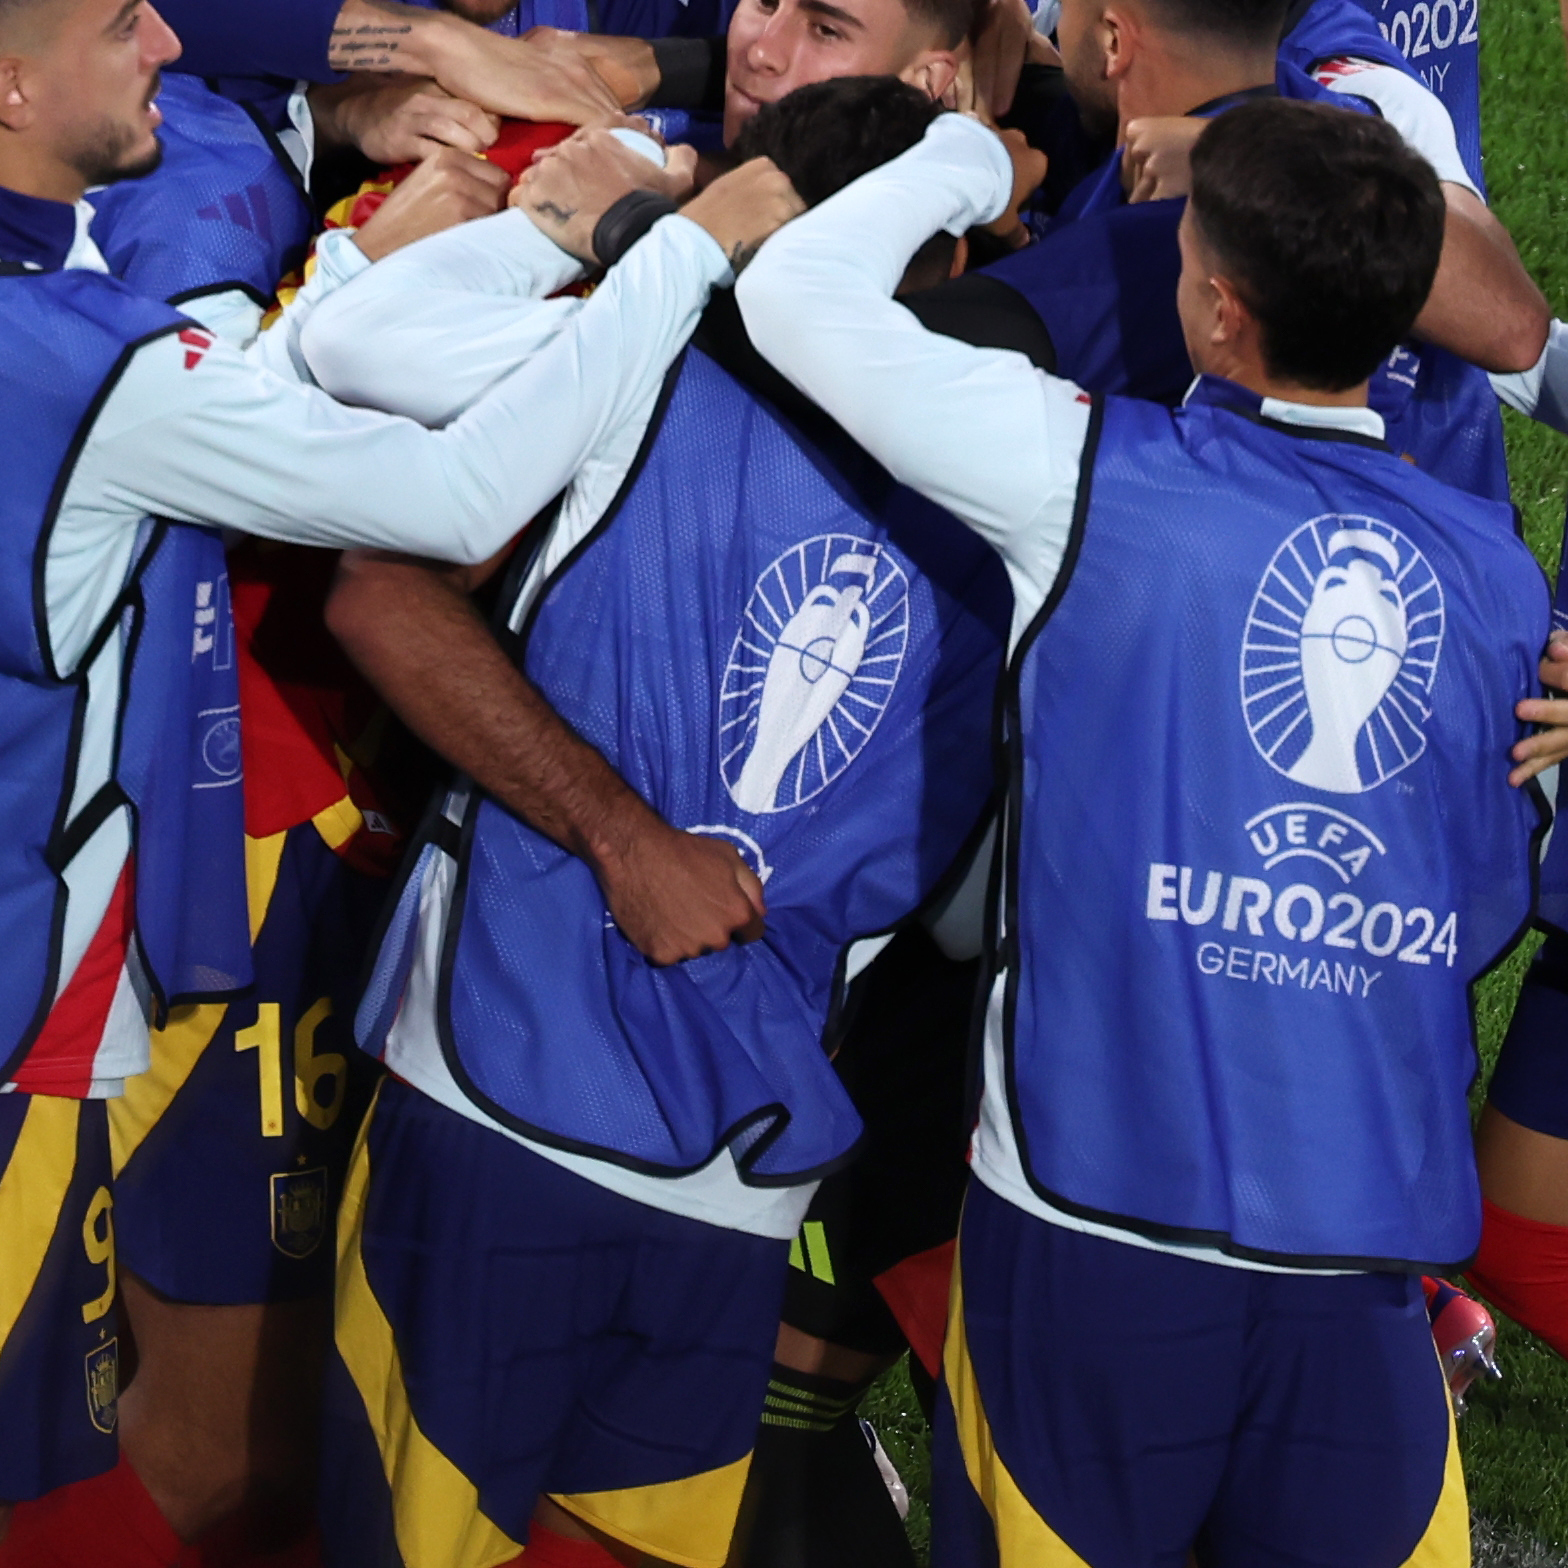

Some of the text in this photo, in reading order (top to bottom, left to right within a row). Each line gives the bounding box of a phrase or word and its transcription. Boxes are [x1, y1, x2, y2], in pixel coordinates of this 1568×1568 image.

[1249, 813, 1373, 876] UEFA
[1146, 862, 1458, 968] EURO2024
[1196, 941, 1383, 999] GERMANY
[234, 996, 347, 1137] 16
[82, 1184, 117, 1324] 9
